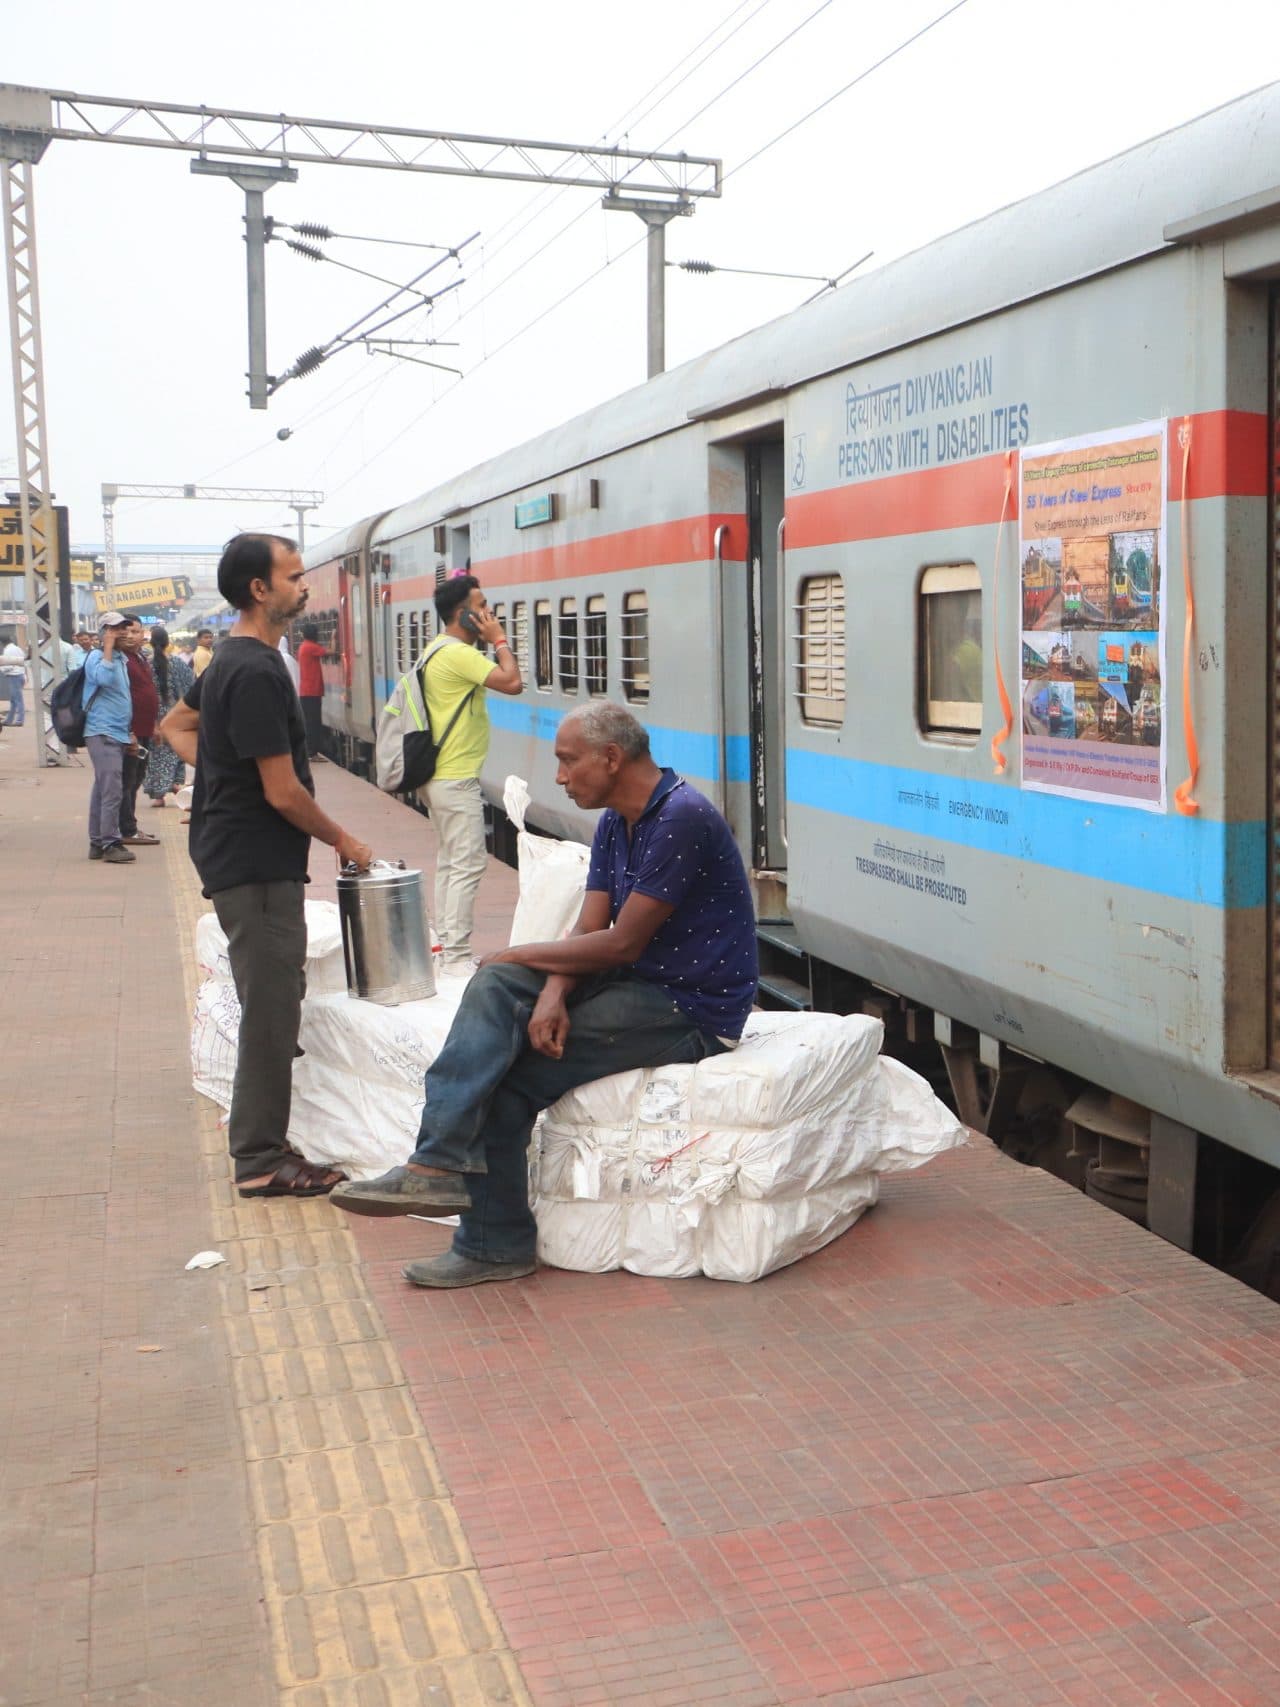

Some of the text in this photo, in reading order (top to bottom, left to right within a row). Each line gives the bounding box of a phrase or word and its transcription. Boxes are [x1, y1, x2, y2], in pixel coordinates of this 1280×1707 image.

[906, 355, 993, 417] DIVYANGJAN
[838, 402, 1029, 479] PERSONS WITH DISABILITIES
[948, 800, 1009, 825] EMERGENCY WINDOW
[896, 869, 915, 889] SHALL
[915, 875, 924, 892] BE
[924, 877, 967, 905] PROSECUTED
